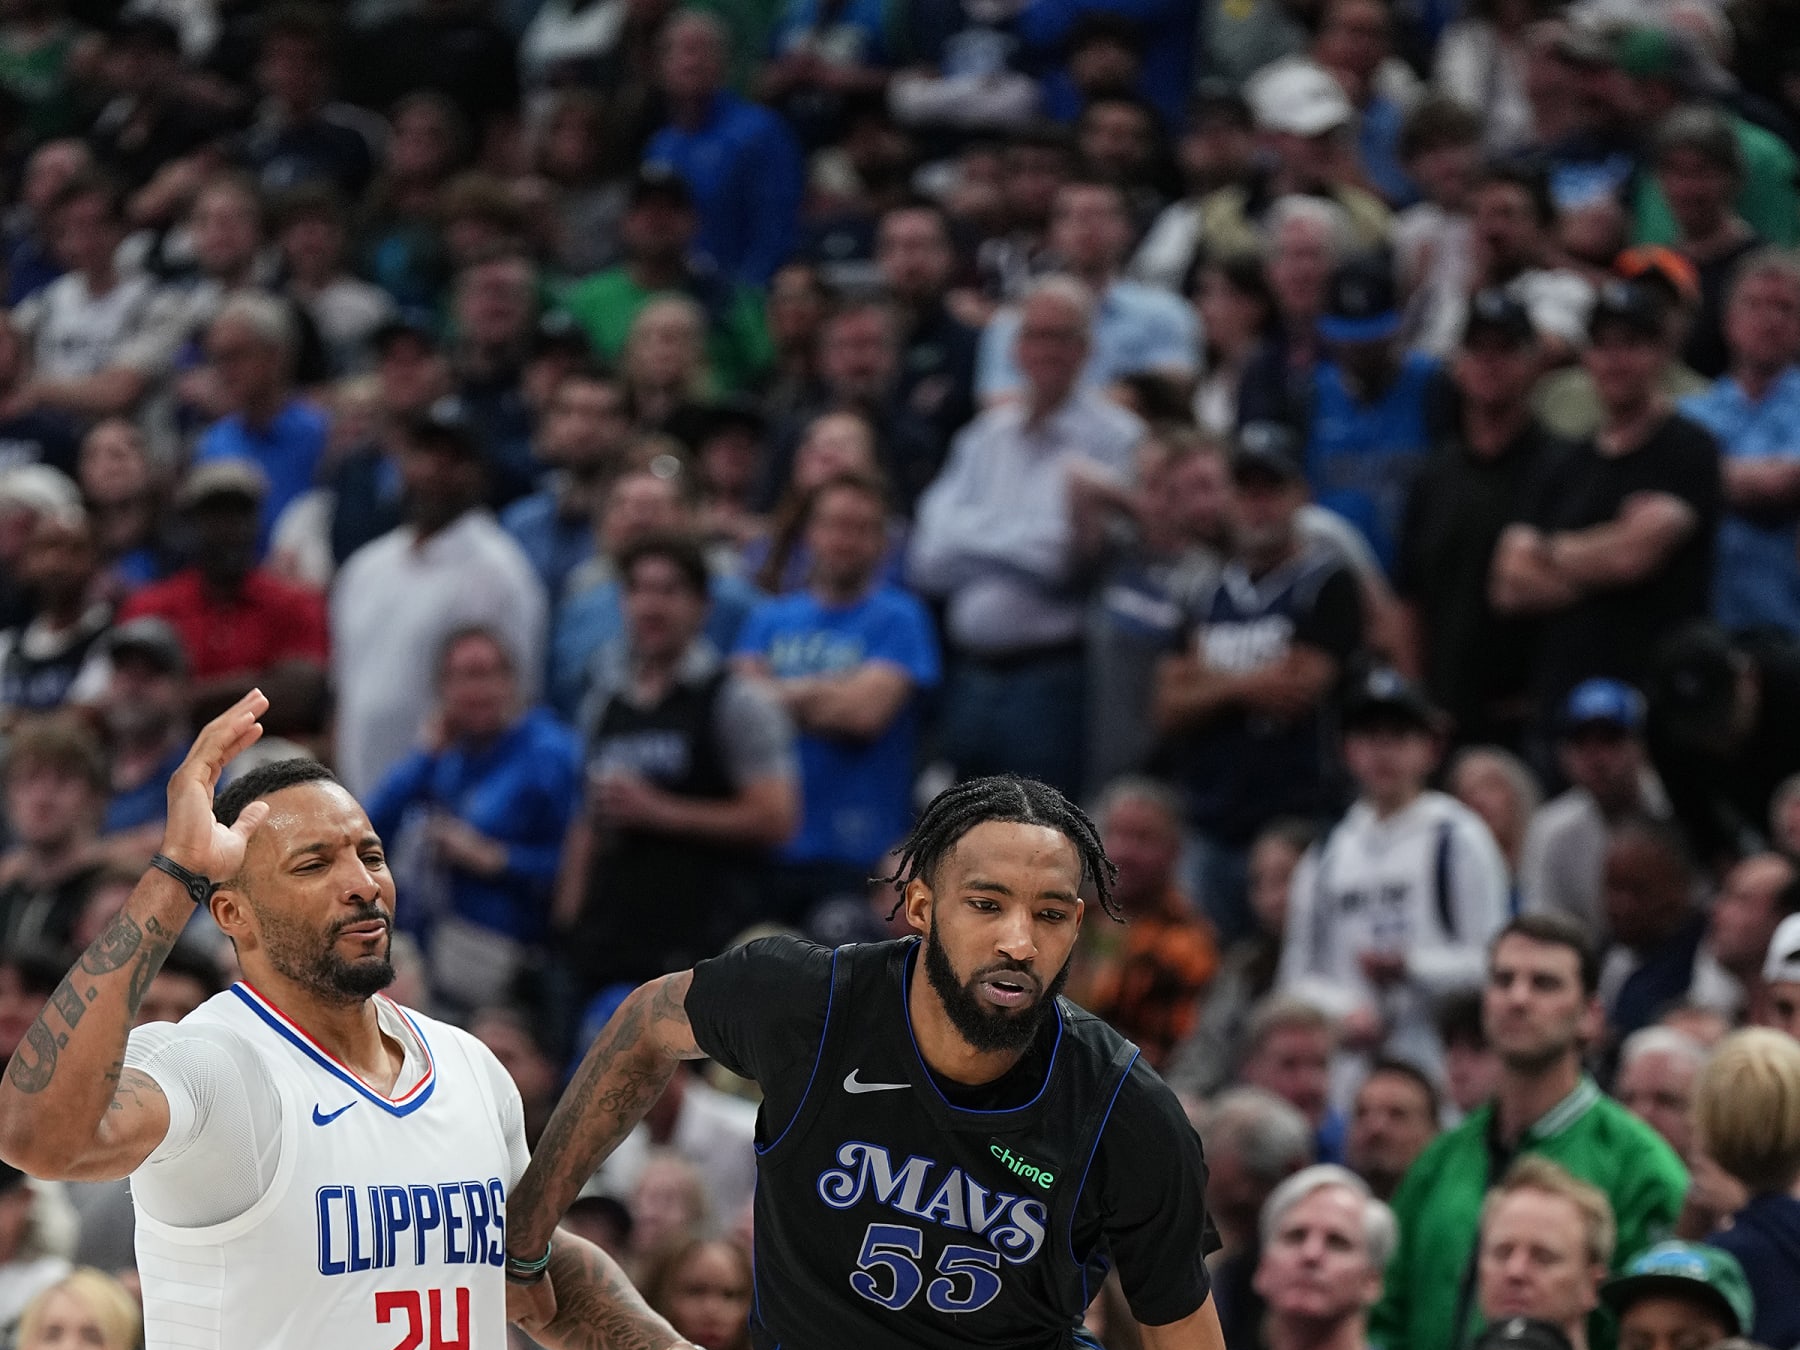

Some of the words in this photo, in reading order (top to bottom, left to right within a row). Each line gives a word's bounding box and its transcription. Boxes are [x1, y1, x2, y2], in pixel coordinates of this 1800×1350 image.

[816, 1140, 1050, 1266] MAVS
[988, 1143, 1055, 1190] chime
[315, 1176, 505, 1277] CLIPPERS
[849, 1222, 1002, 1314] 55
